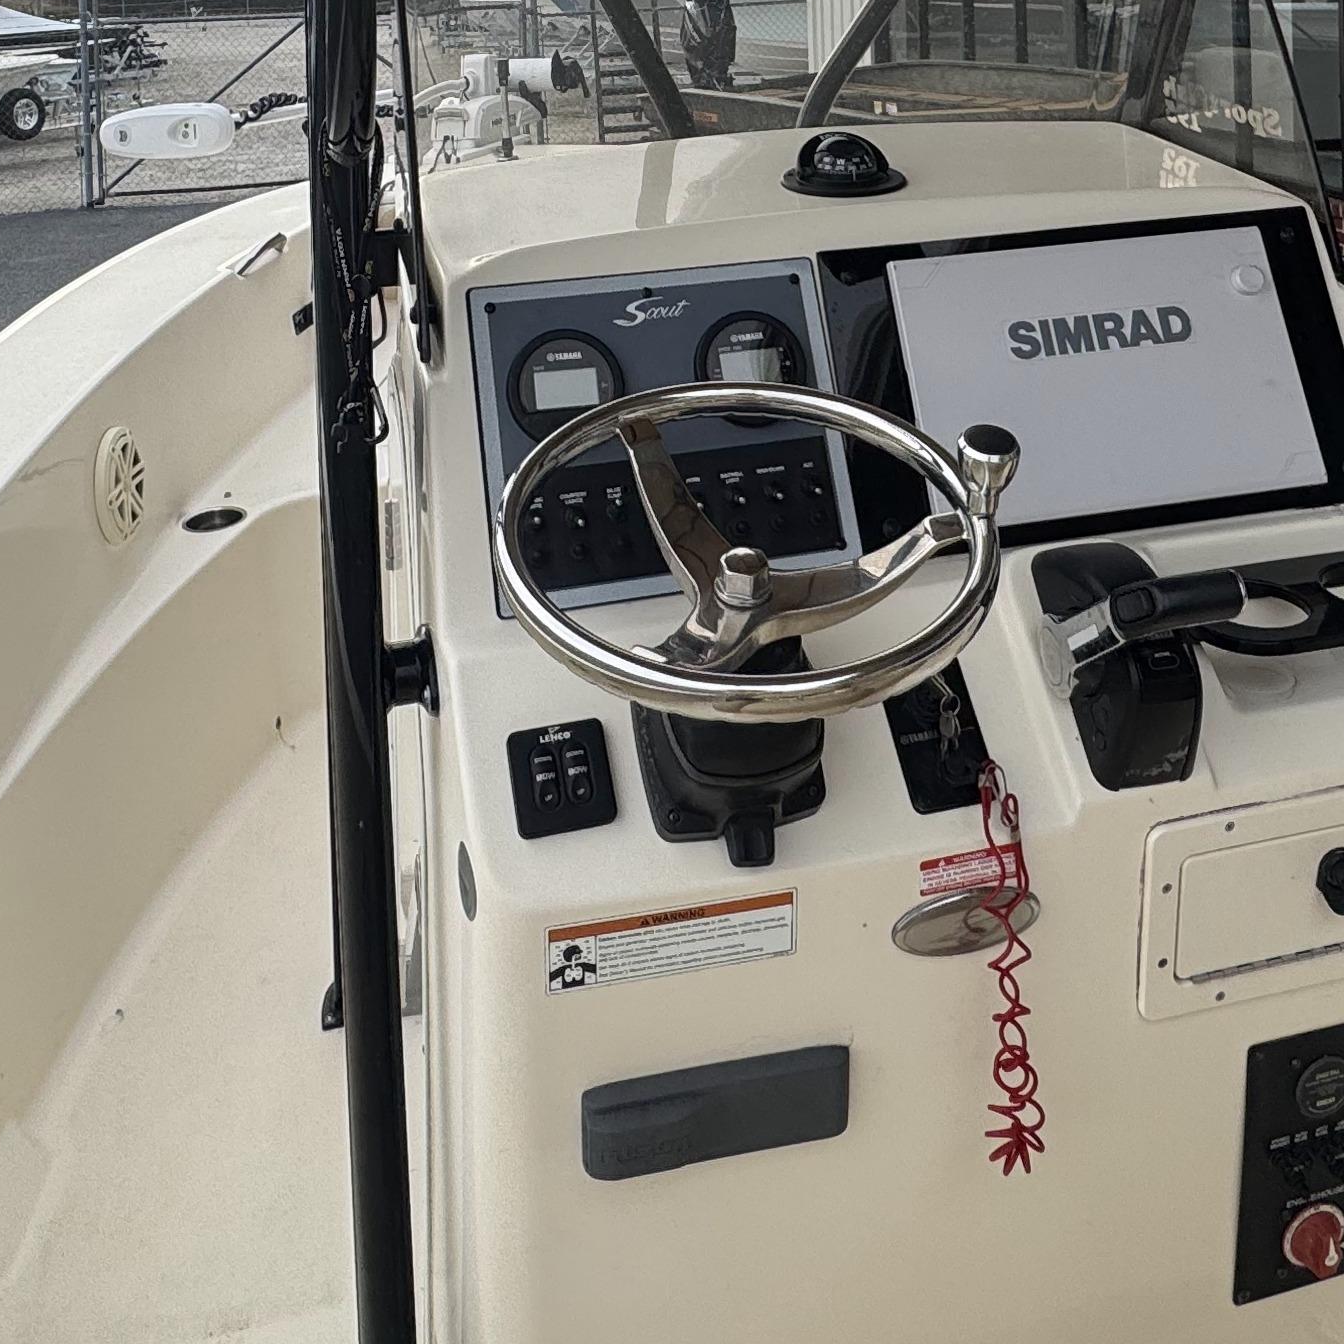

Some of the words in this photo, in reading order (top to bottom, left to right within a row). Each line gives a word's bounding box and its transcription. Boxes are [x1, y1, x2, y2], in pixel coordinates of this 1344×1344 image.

[613, 296, 690, 327] Scout
[738, 331, 764, 342] YAMAHA
[1007, 306, 1193, 360] SIMRAD
[555, 351, 583, 361] YAMAHA
[539, 731, 571, 744] LENCO
[652, 908, 706, 925] WARNING
